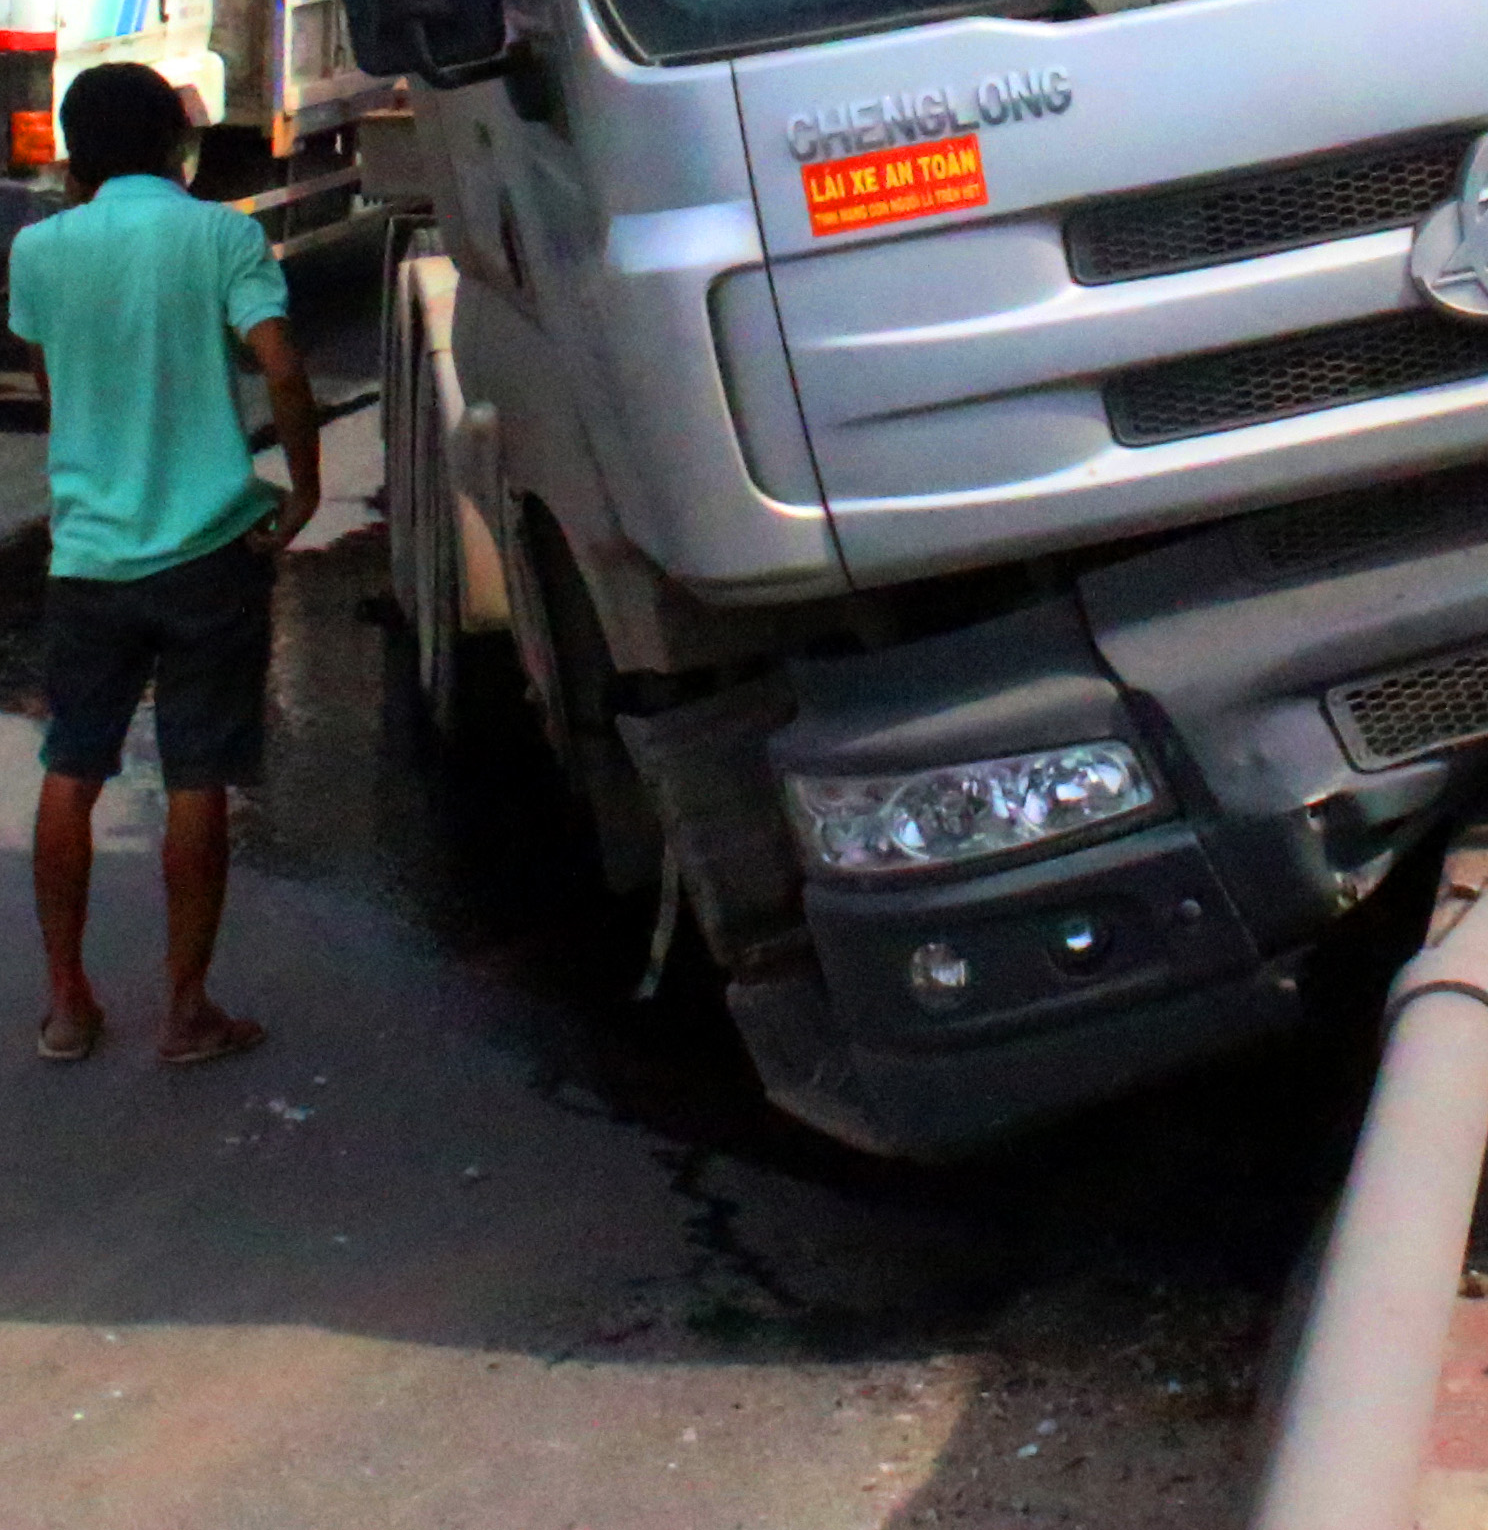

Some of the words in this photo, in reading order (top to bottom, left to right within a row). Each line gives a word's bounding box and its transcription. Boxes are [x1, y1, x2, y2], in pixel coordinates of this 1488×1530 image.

[787, 68, 1073, 163] CHENGLONG
[850, 166, 880, 195] XE
[885, 161, 914, 189] AN
[917, 144, 977, 182] TOÀN
